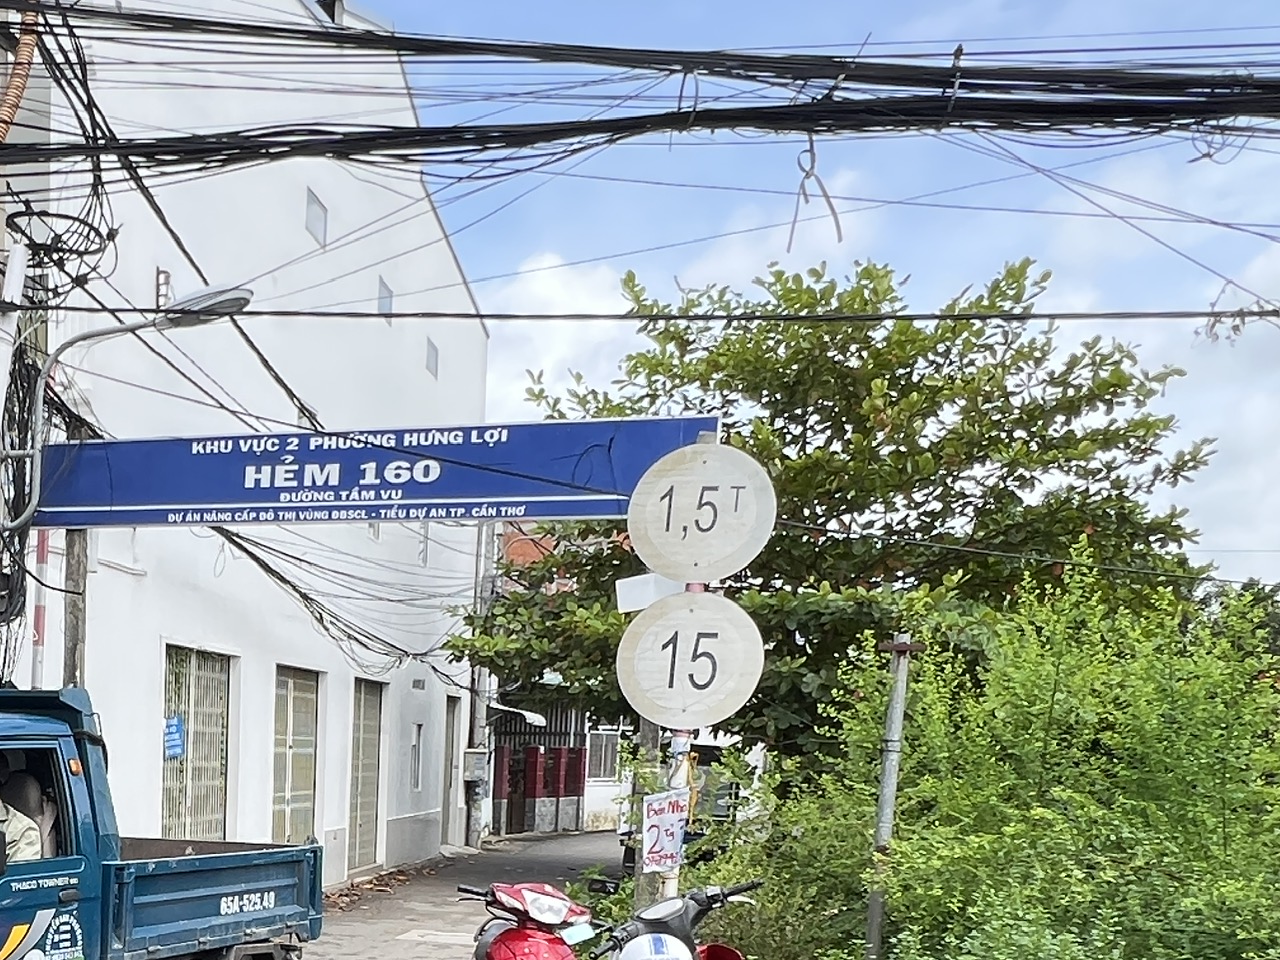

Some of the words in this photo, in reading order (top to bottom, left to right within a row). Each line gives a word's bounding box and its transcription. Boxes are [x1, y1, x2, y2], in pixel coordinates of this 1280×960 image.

[191, 440, 233, 455] KHU
[239, 437, 280, 456] VỰC
[285, 437, 300, 451] 2
[403, 430, 464, 447] HƯNG
[470, 428, 509, 447] LỢI
[244, 455, 341, 488] HẺM
[359, 459, 441, 486] 160
[280, 488, 335, 502] ĐƯỜNG
[379, 489, 403, 500] VU
[167, 511, 183, 523] DỰ
[203, 510, 232, 522] NÂNG
[234, 508, 257, 521] CẤP
[277, 511, 296, 522] THỊ
[299, 509, 329, 520] VÙNG
[379, 505, 407, 519] TIỂU
[409, 507, 428, 520] DỰ
[499, 505, 526, 517] THƠ
[660, 630, 719, 690] 15
[646, 824, 665, 855] 2
[10, 880, 37, 892] THACO
[220, 891, 276, 916] 65A-525.49
